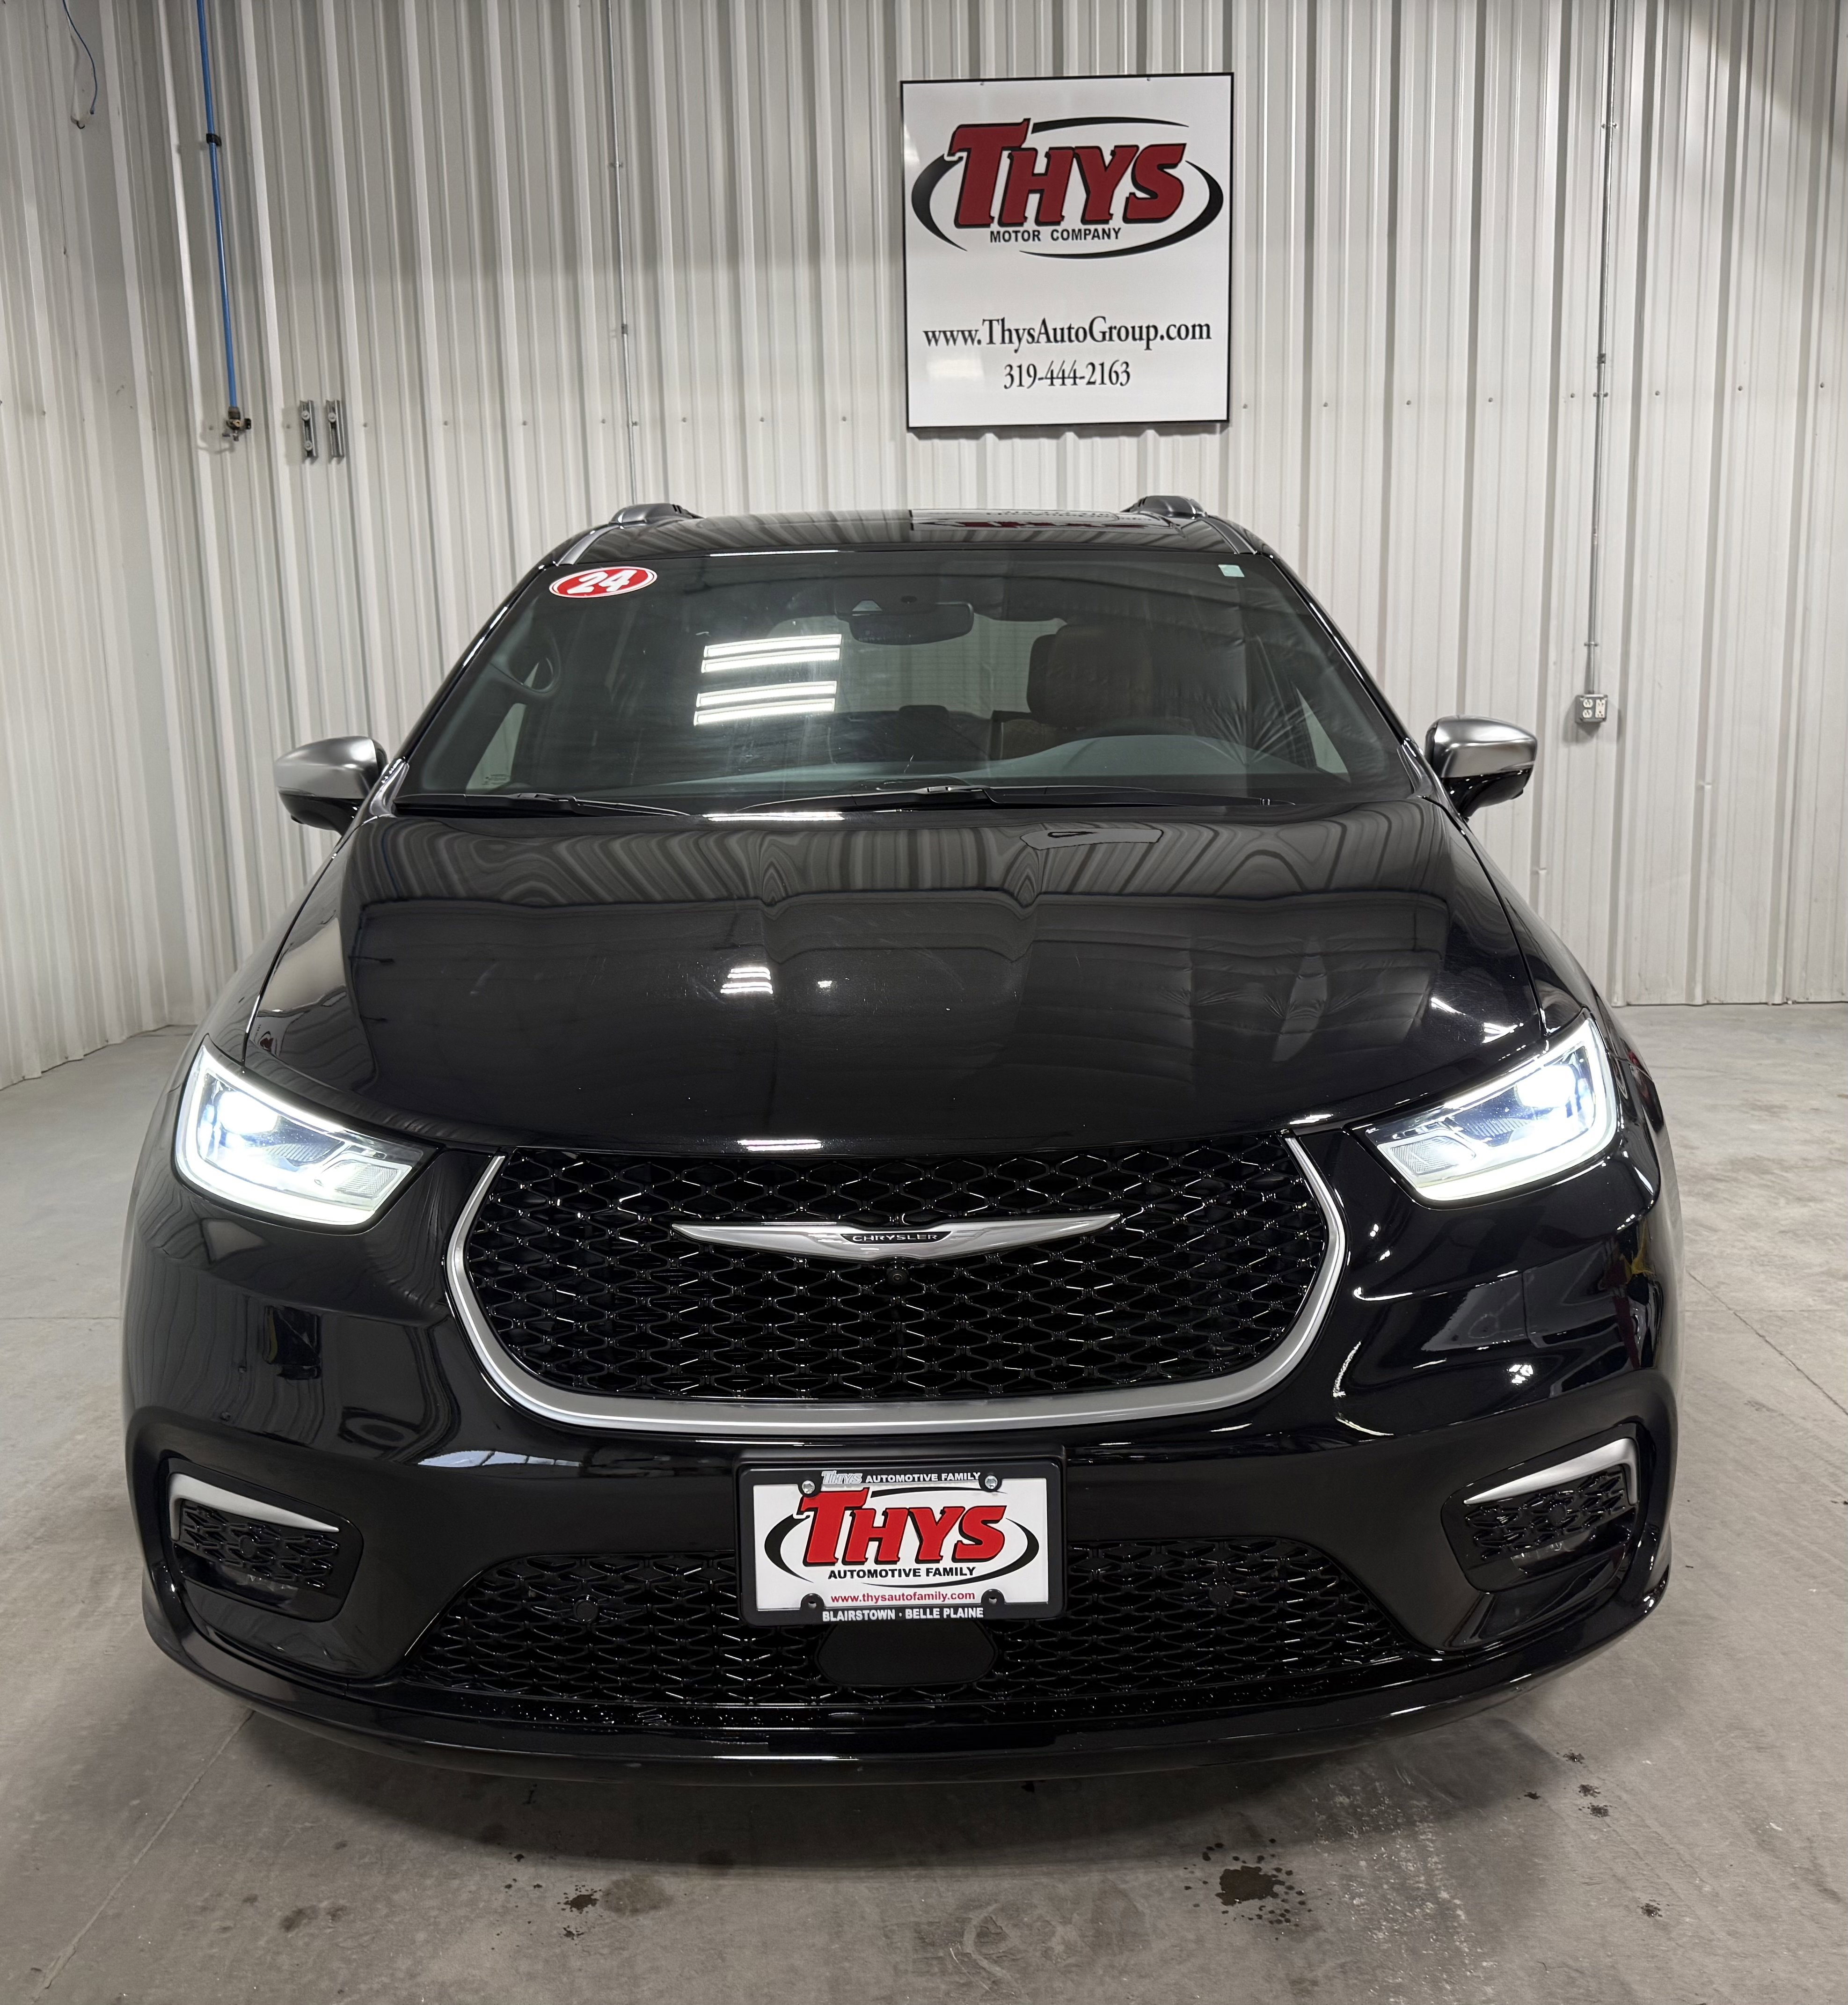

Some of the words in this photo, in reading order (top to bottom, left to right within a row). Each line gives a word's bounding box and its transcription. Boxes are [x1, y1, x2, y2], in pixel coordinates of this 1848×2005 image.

[947, 117, 1187, 228] THYS
[989, 230, 1041, 243] MOTOR
[1051, 227, 1121, 242] COMPANY
[923, 315, 1213, 353] www.ThysAutoGroup.com
[1003, 360, 1131, 389] 319-444-2163
[567, 569, 637, 594] 24
[866, 1474, 938, 1483] AUTOMOTIVE
[941, 1472, 981, 1482] FAMILY
[797, 1487, 1007, 1567] THYS
[828, 1568, 921, 1580] AUTOMOTIVE
[926, 1566, 976, 1577] FAMILY
[831, 1591, 975, 1604] www.thysautofamily.com
[823, 1609, 895, 1622] BLAIRSTOWN
[905, 1608, 941, 1619] BELLE
[943, 1607, 984, 1618] PLAINE
